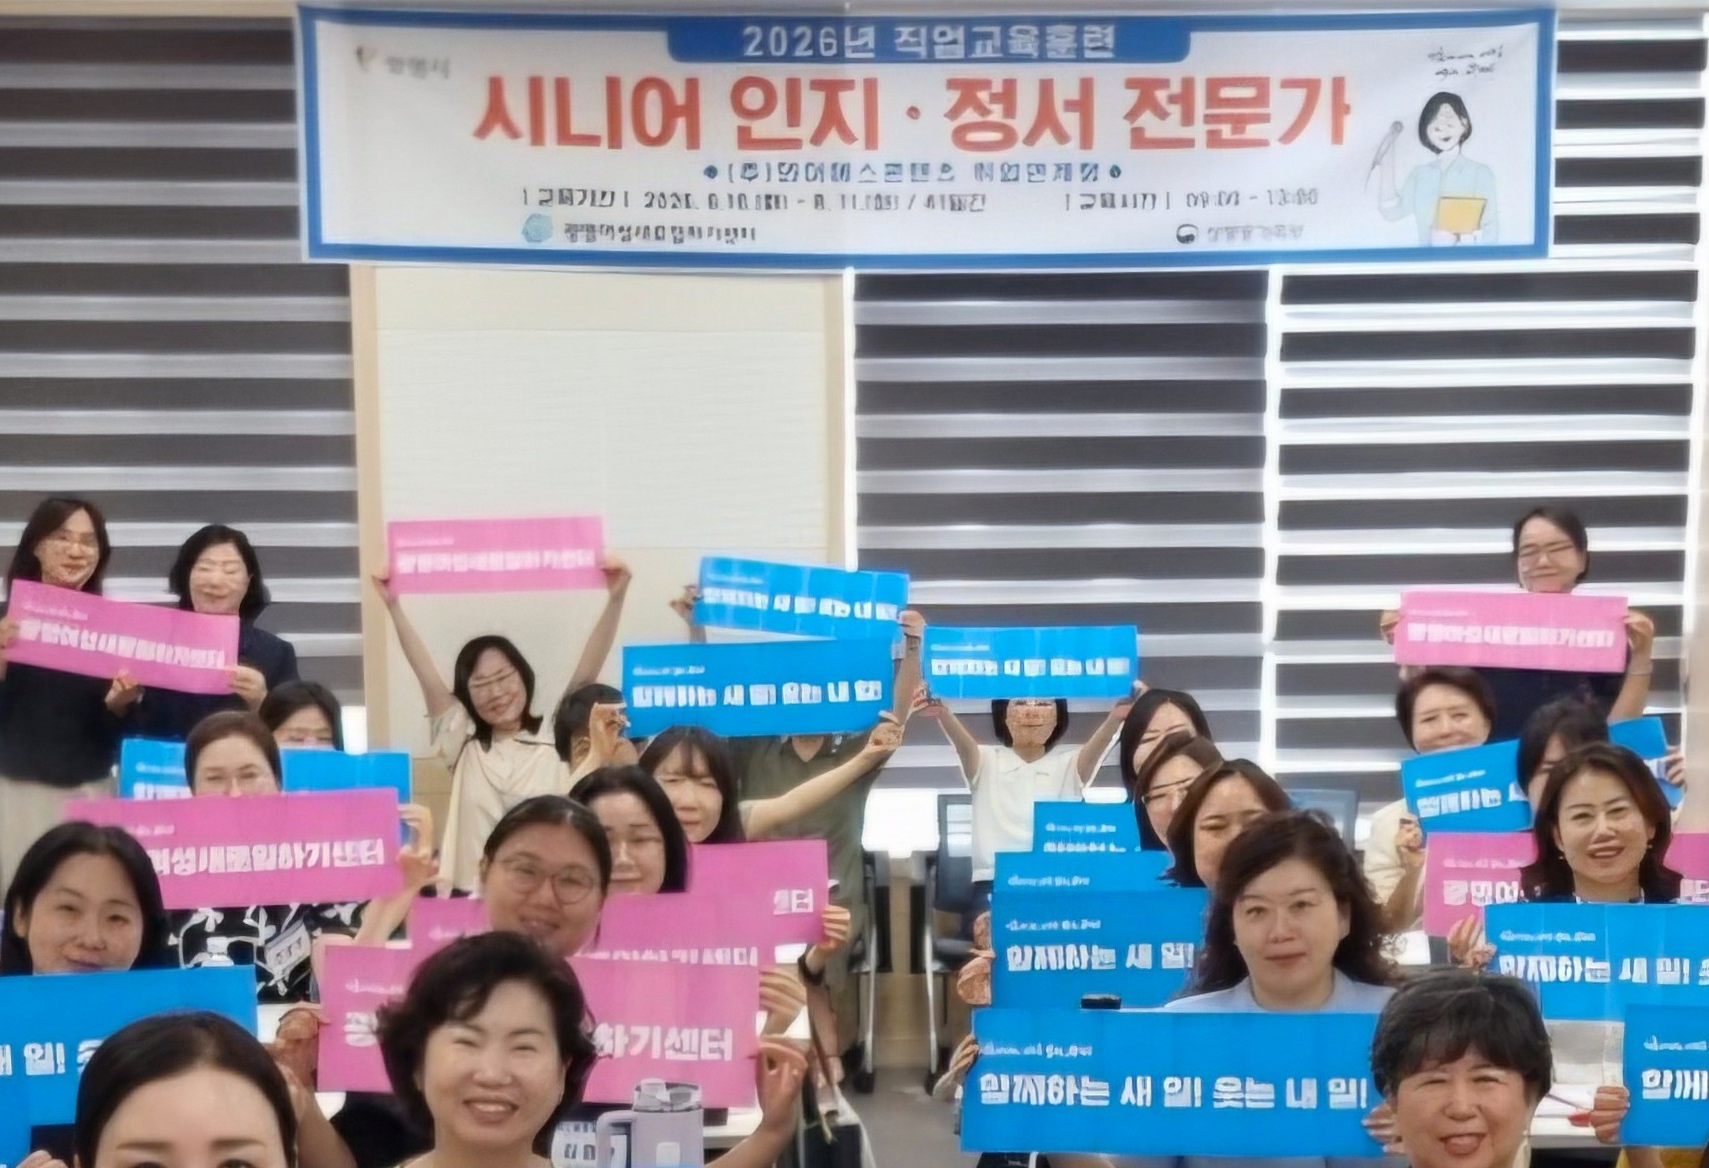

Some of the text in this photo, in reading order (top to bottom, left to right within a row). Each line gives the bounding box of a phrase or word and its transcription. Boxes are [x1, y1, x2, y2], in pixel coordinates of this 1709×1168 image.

[743, 24, 1116, 60] 2026년 직업교육훈련
[473, 75, 701, 150] 시니어
[730, 75, 879, 151] 인지
[943, 76, 1094, 152] 정서
[1122, 75, 1351, 150] 전문가
[24, 1043, 65, 1075] 일!
[1121, 1076, 1151, 1106] 새
